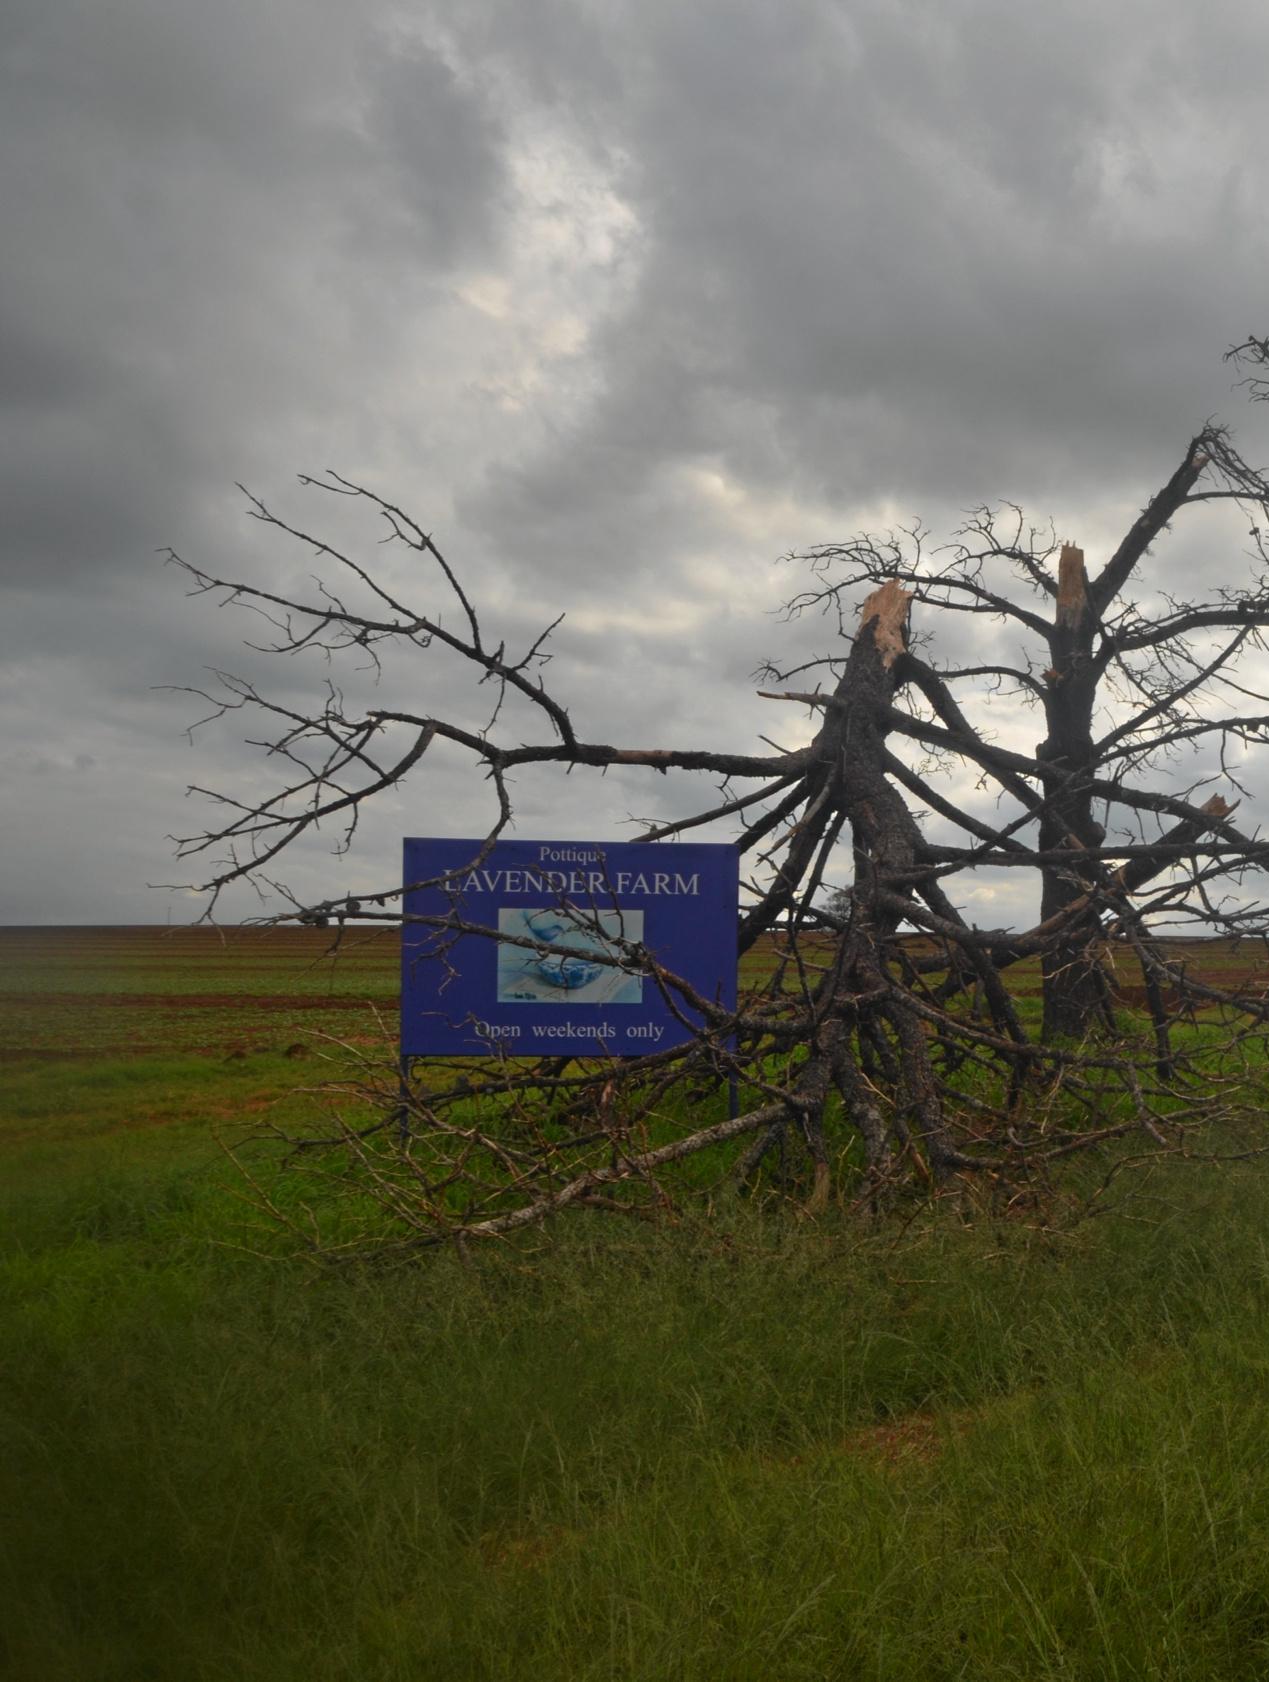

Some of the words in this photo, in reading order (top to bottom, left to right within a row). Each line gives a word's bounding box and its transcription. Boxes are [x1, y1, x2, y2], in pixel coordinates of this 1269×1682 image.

[539, 846, 606, 865] Pottique
[443, 869, 608, 894] LAVENDER
[616, 872, 700, 896] FARM
[475, 1022, 521, 1041] Open
[533, 1022, 617, 1039] weekends
[627, 1022, 664, 1042] only
